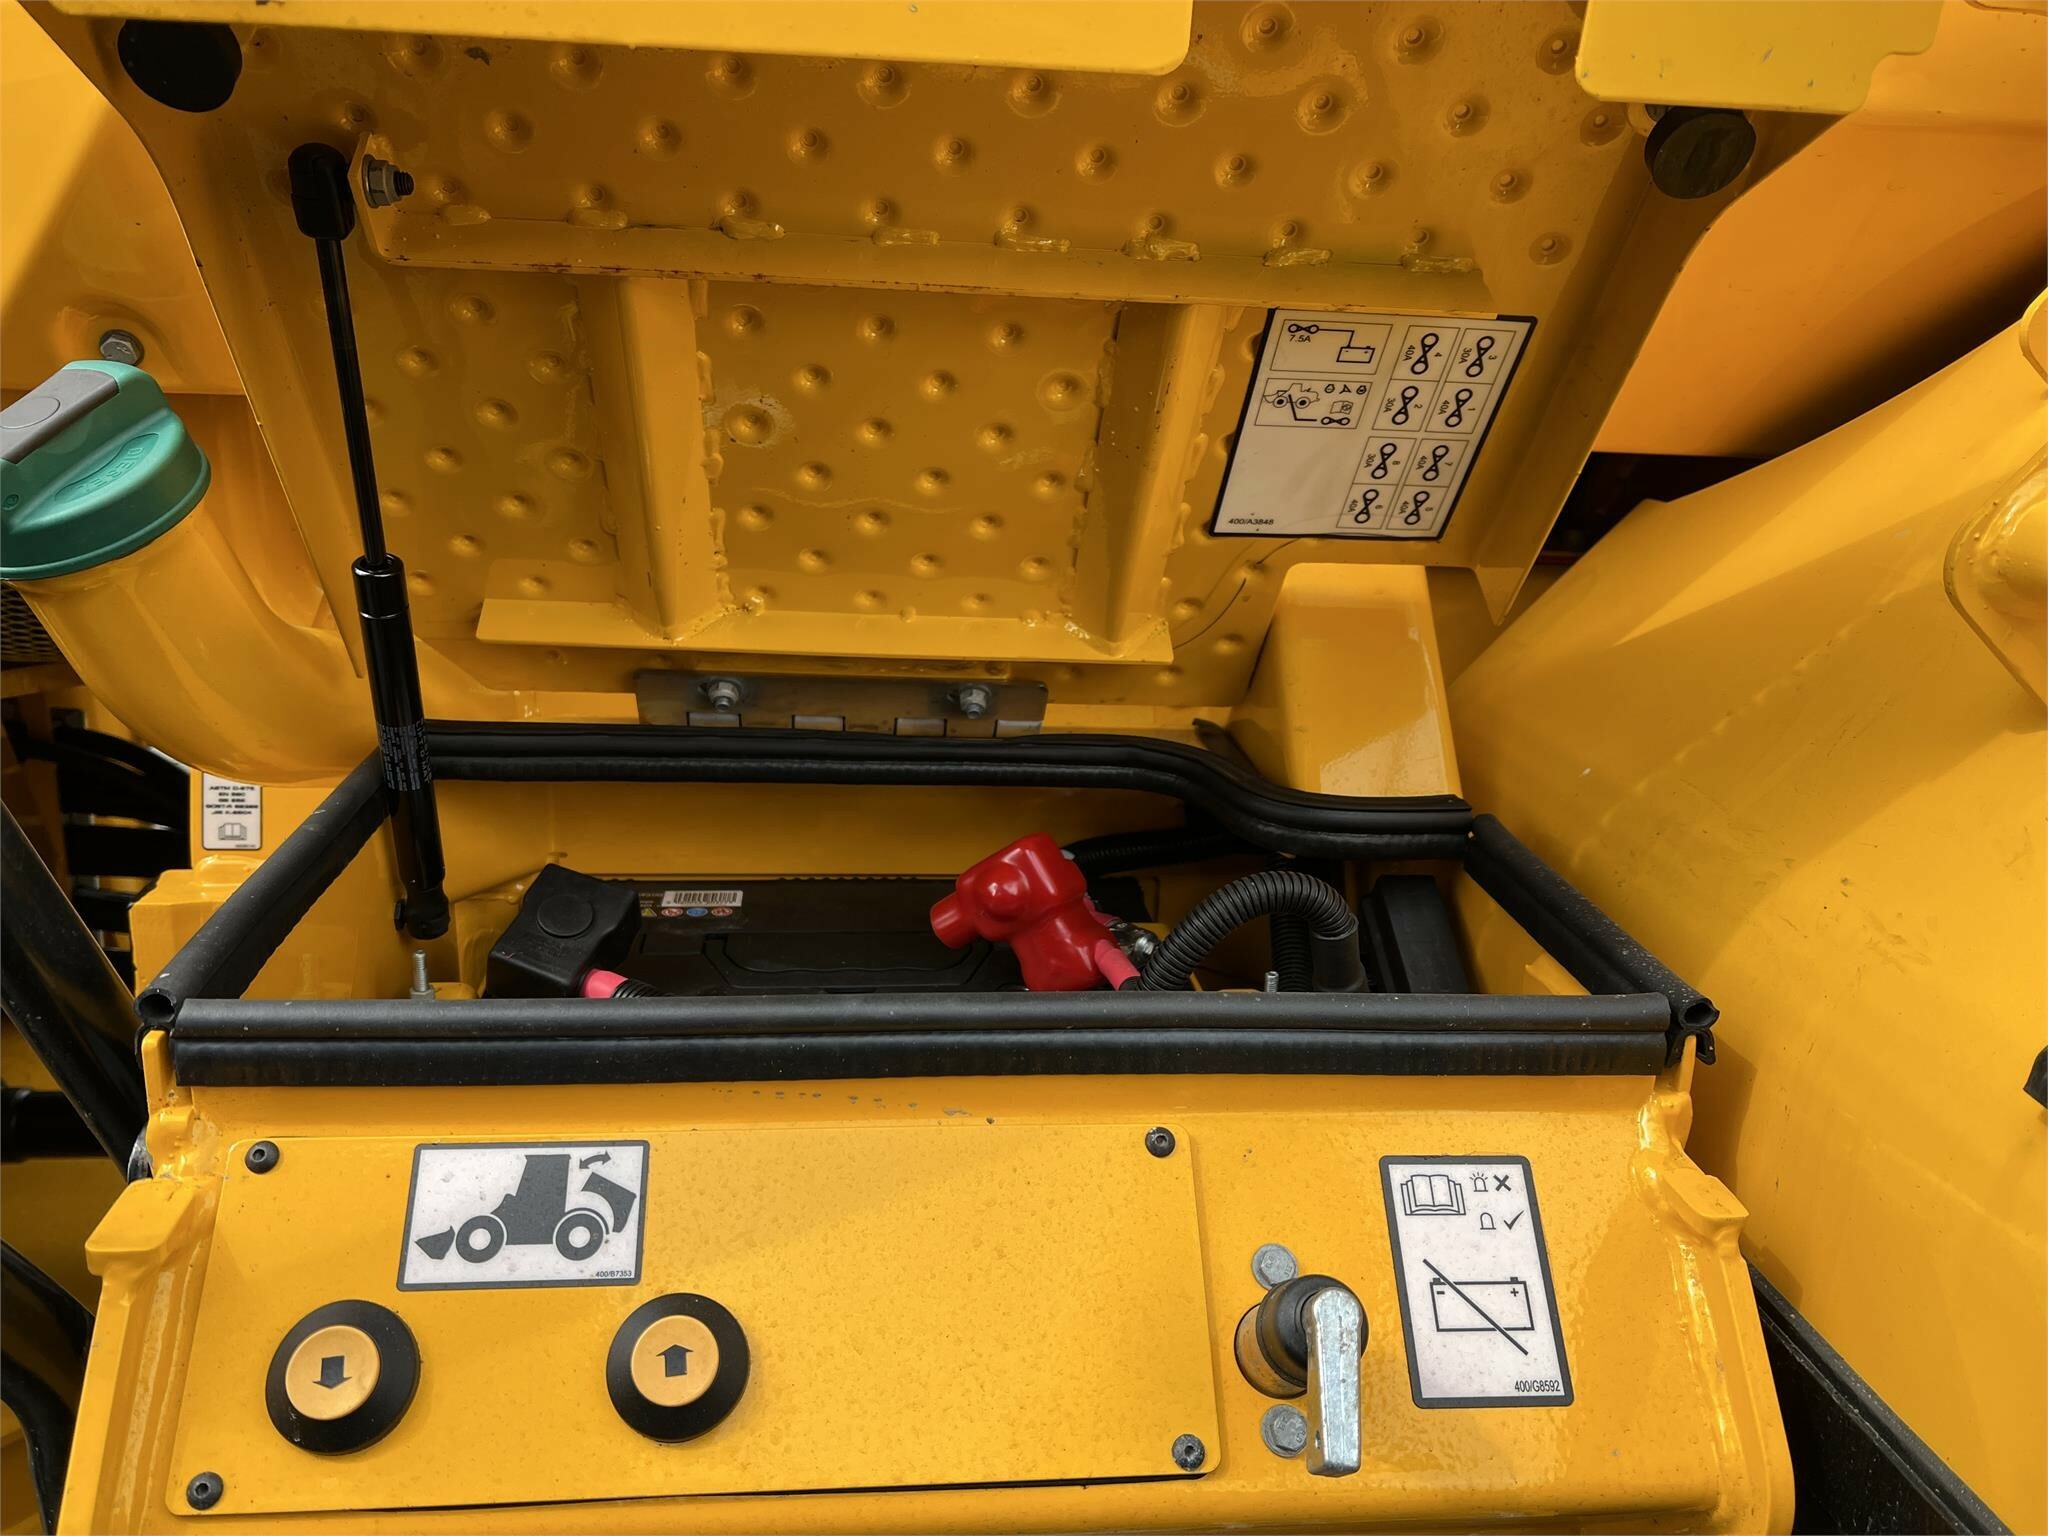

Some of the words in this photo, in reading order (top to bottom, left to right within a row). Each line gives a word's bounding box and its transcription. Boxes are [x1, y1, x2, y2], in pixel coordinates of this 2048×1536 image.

[1289, 334, 1311, 343] 7.5A
[1404, 344, 1415, 362] 40A
[1458, 347, 1473, 364] 30A
[1383, 397, 1396, 413] 30A
[1438, 399, 1450, 415] 40A
[1364, 453, 1376, 469] 30A
[1416, 455, 1428, 470] 40A
[1347, 499, 1359, 513] 40A
[1398, 500, 1410, 514] 40A
[595, 1270, 632, 1278] 400/B7353
[1514, 1379, 1561, 1393] 400/G8592
